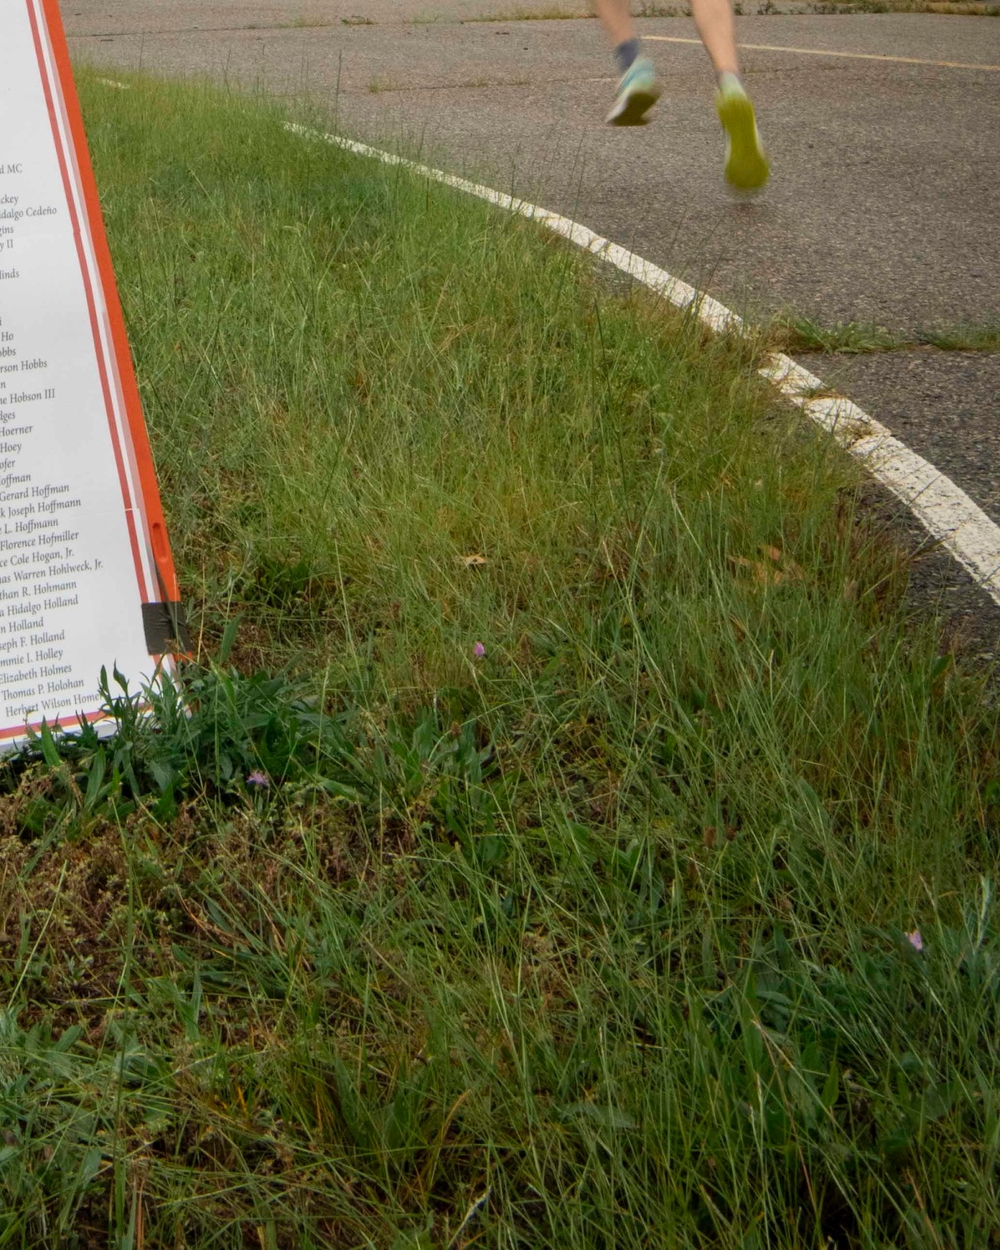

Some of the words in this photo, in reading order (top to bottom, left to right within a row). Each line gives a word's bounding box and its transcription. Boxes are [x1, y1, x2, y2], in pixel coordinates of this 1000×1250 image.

[6, 162, 22, 174] MC
[25, 205, 57, 217] Cedeño
[20, 357, 47, 370] Hobbs
[9, 391, 42, 404] Hobson
[44, 387, 55, 399] III
[31, 483, 69, 498] Hoffman
[7, 502, 35, 519] Joseph
[37, 498, 81, 514] Hoffmann
[0, 538, 36, 551] Florence
[38, 529, 79, 547] Hofmiller
[7, 601, 41, 616] Hidalgo
[43, 593, 78, 610] Holland
[39, 663, 72, 677] Holmes
